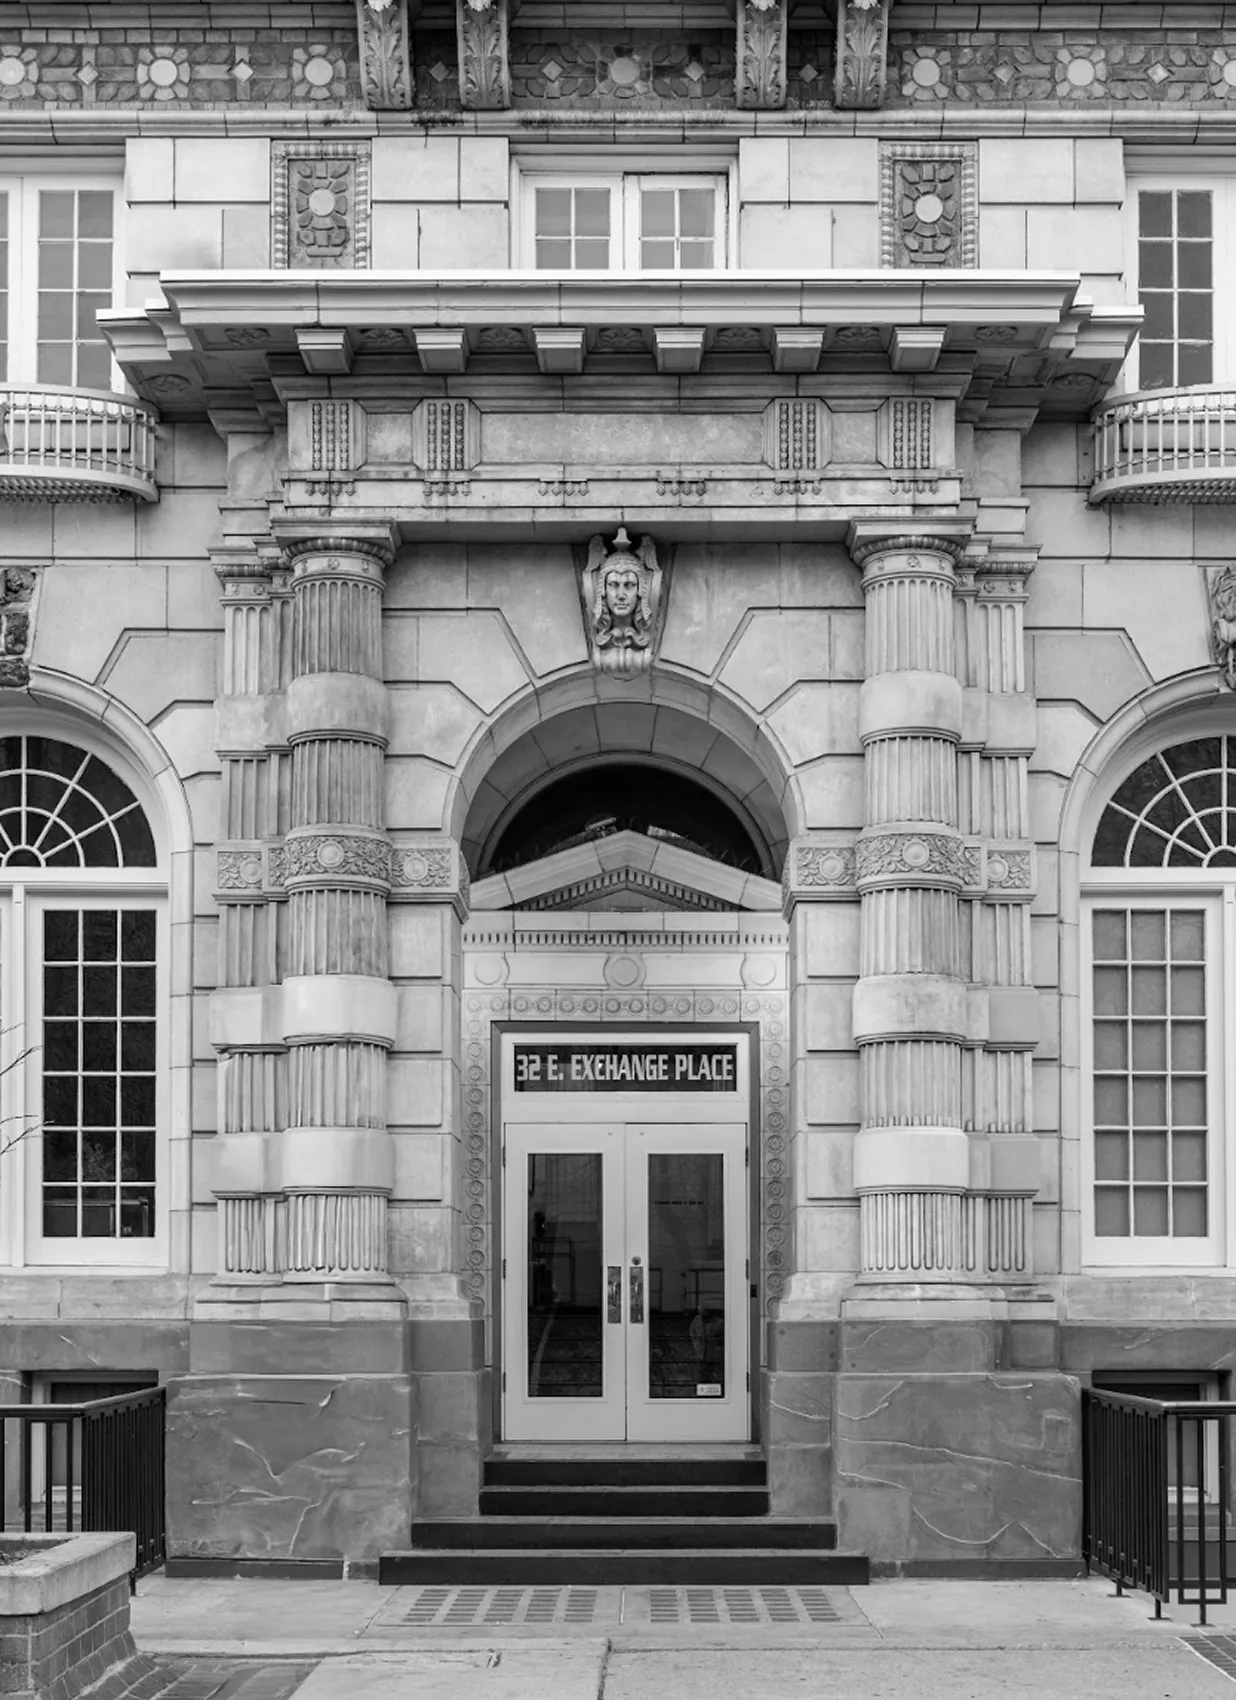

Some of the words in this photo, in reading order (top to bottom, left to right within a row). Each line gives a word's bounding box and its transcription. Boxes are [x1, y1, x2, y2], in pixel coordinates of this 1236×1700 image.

[516, 1054, 541, 1081] 32
[547, 1054, 564, 1081] E.
[571, 1054, 669, 1081] EXCHANGE
[675, 1054, 733, 1081] PLACE
